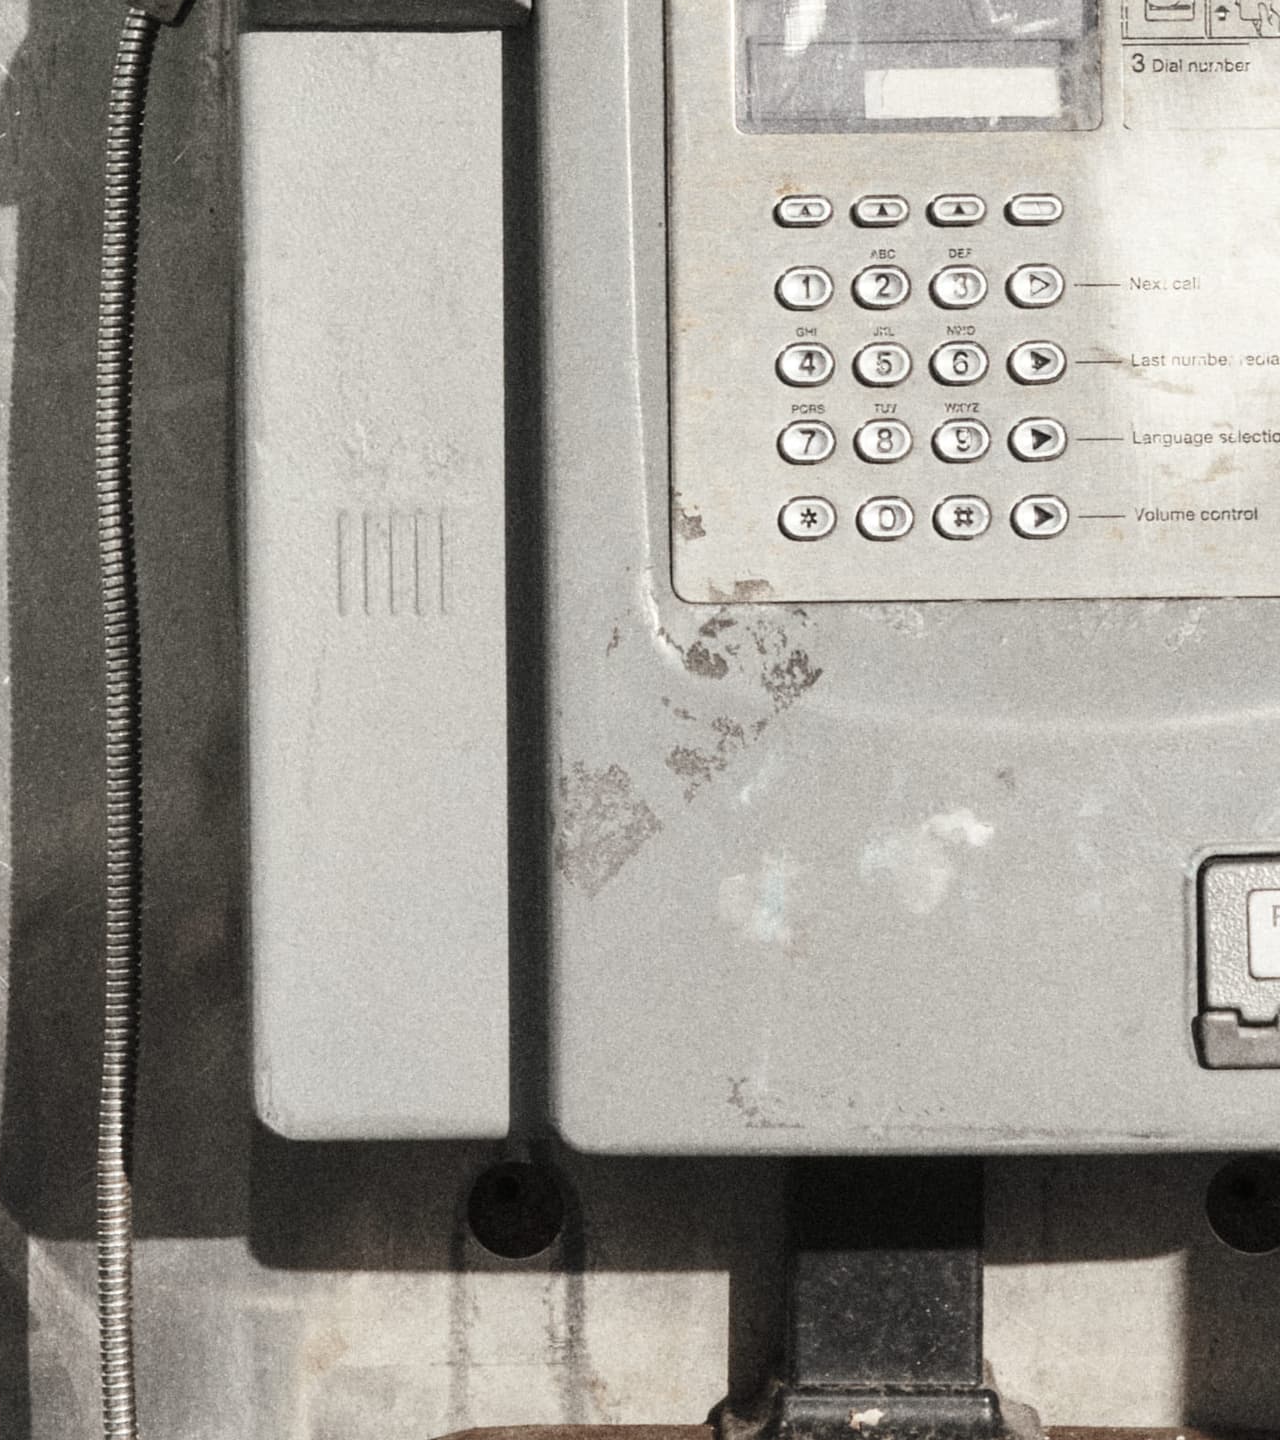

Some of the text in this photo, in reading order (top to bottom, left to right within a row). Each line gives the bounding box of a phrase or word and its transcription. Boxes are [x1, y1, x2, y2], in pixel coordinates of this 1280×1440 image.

[1131, 53, 1251, 73] 3 Dial number
[870, 248, 897, 260] ABC
[948, 248, 974, 260] DEF
[801, 275, 811, 299] 1
[874, 273, 891, 298] 2
[953, 274, 969, 300] 3
[1172, 276, 1201, 291] call
[798, 351, 816, 376] 4
[875, 351, 893, 376] 5
[952, 350, 969, 375] 6
[1130, 353, 1166, 367] Last
[799, 429, 816, 455] 7
[876, 428, 894, 453] 8
[955, 428, 971, 452] 9
[1132, 431, 1214, 448] Language
[878, 506, 896, 531] 0
[1134, 507, 1259, 522] Volume control
